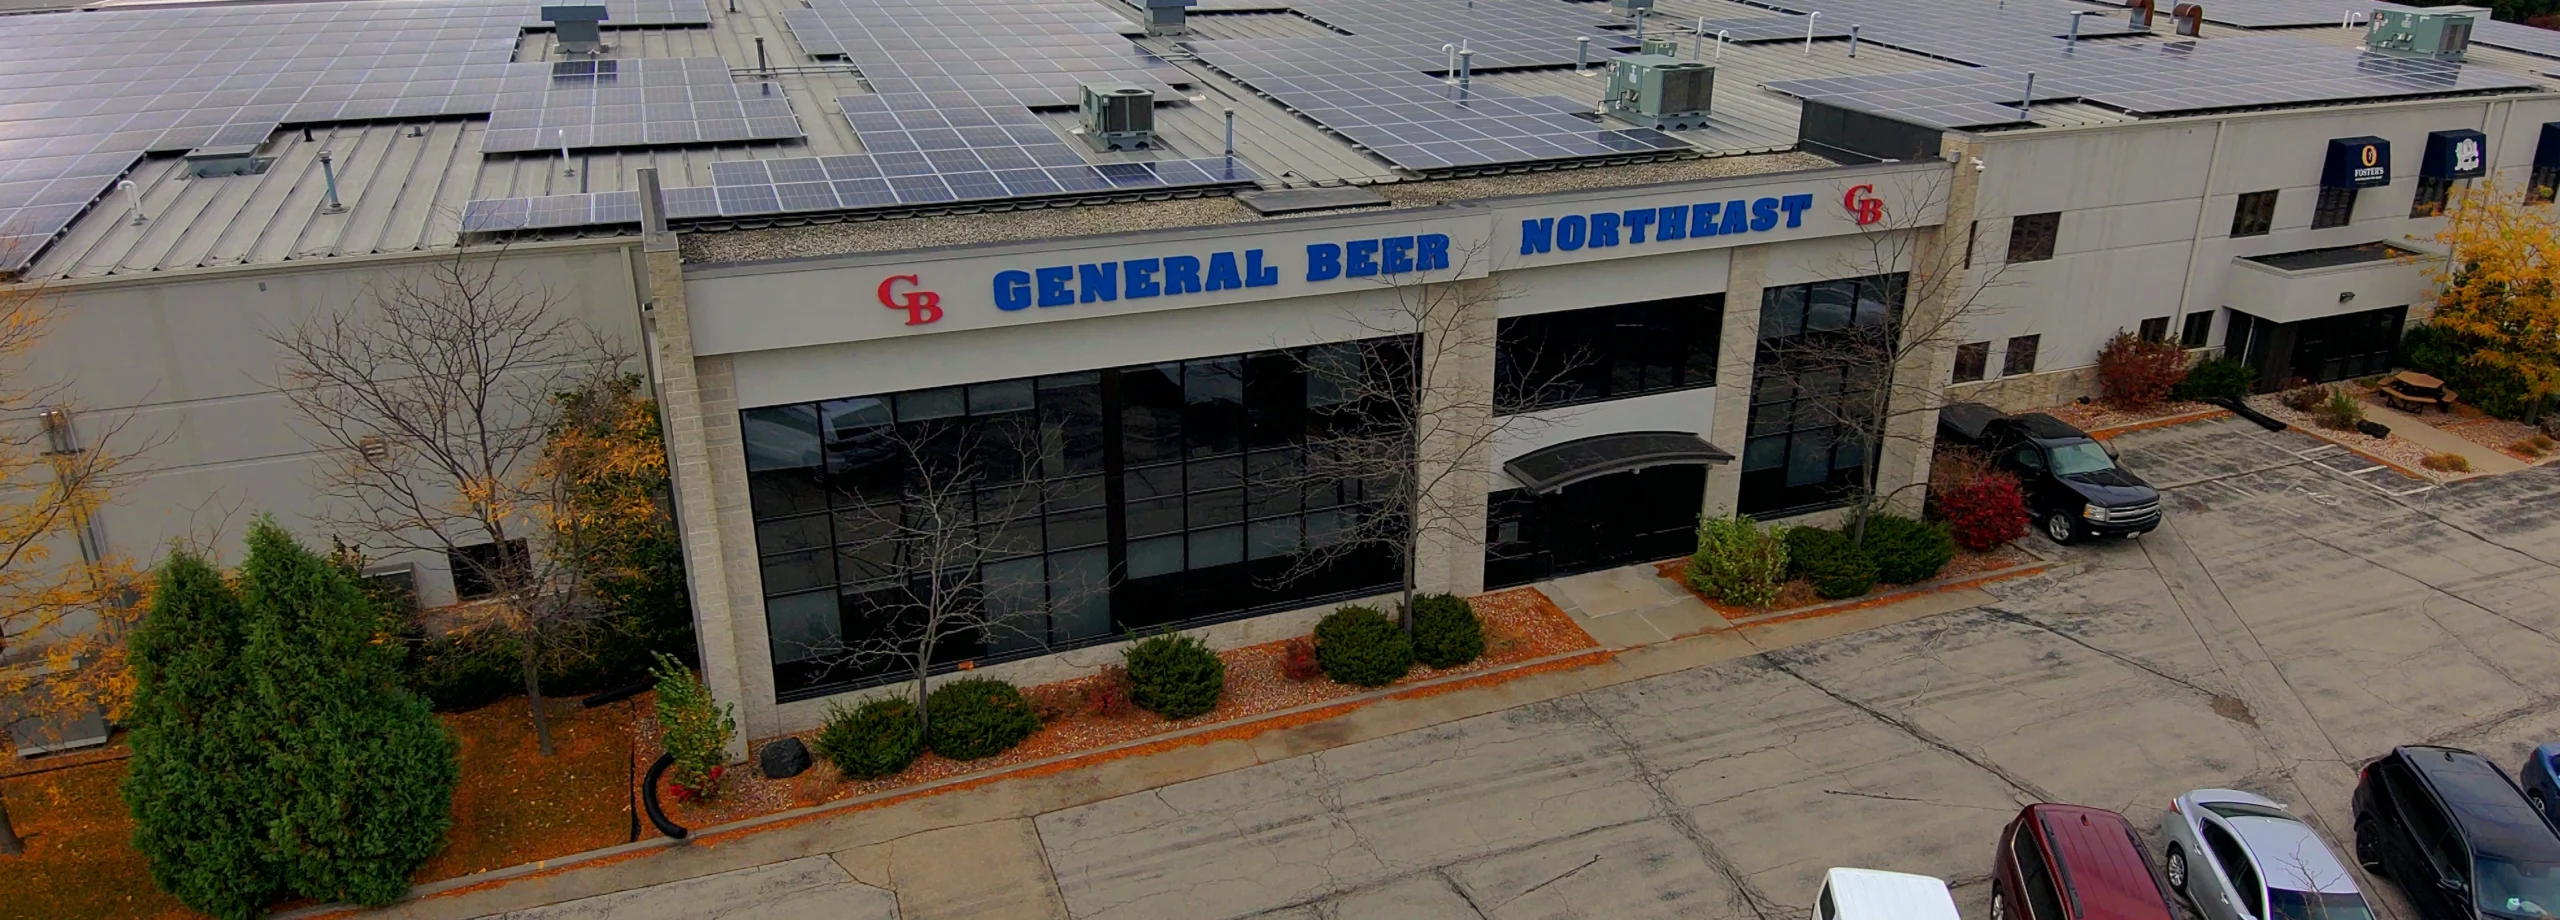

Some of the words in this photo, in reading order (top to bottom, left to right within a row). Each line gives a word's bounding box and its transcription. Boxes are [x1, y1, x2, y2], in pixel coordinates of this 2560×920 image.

[993, 248, 1279, 311] GENERAL
[1306, 233, 1450, 282] BEER
[1520, 193, 1813, 255] NORTHEAST
